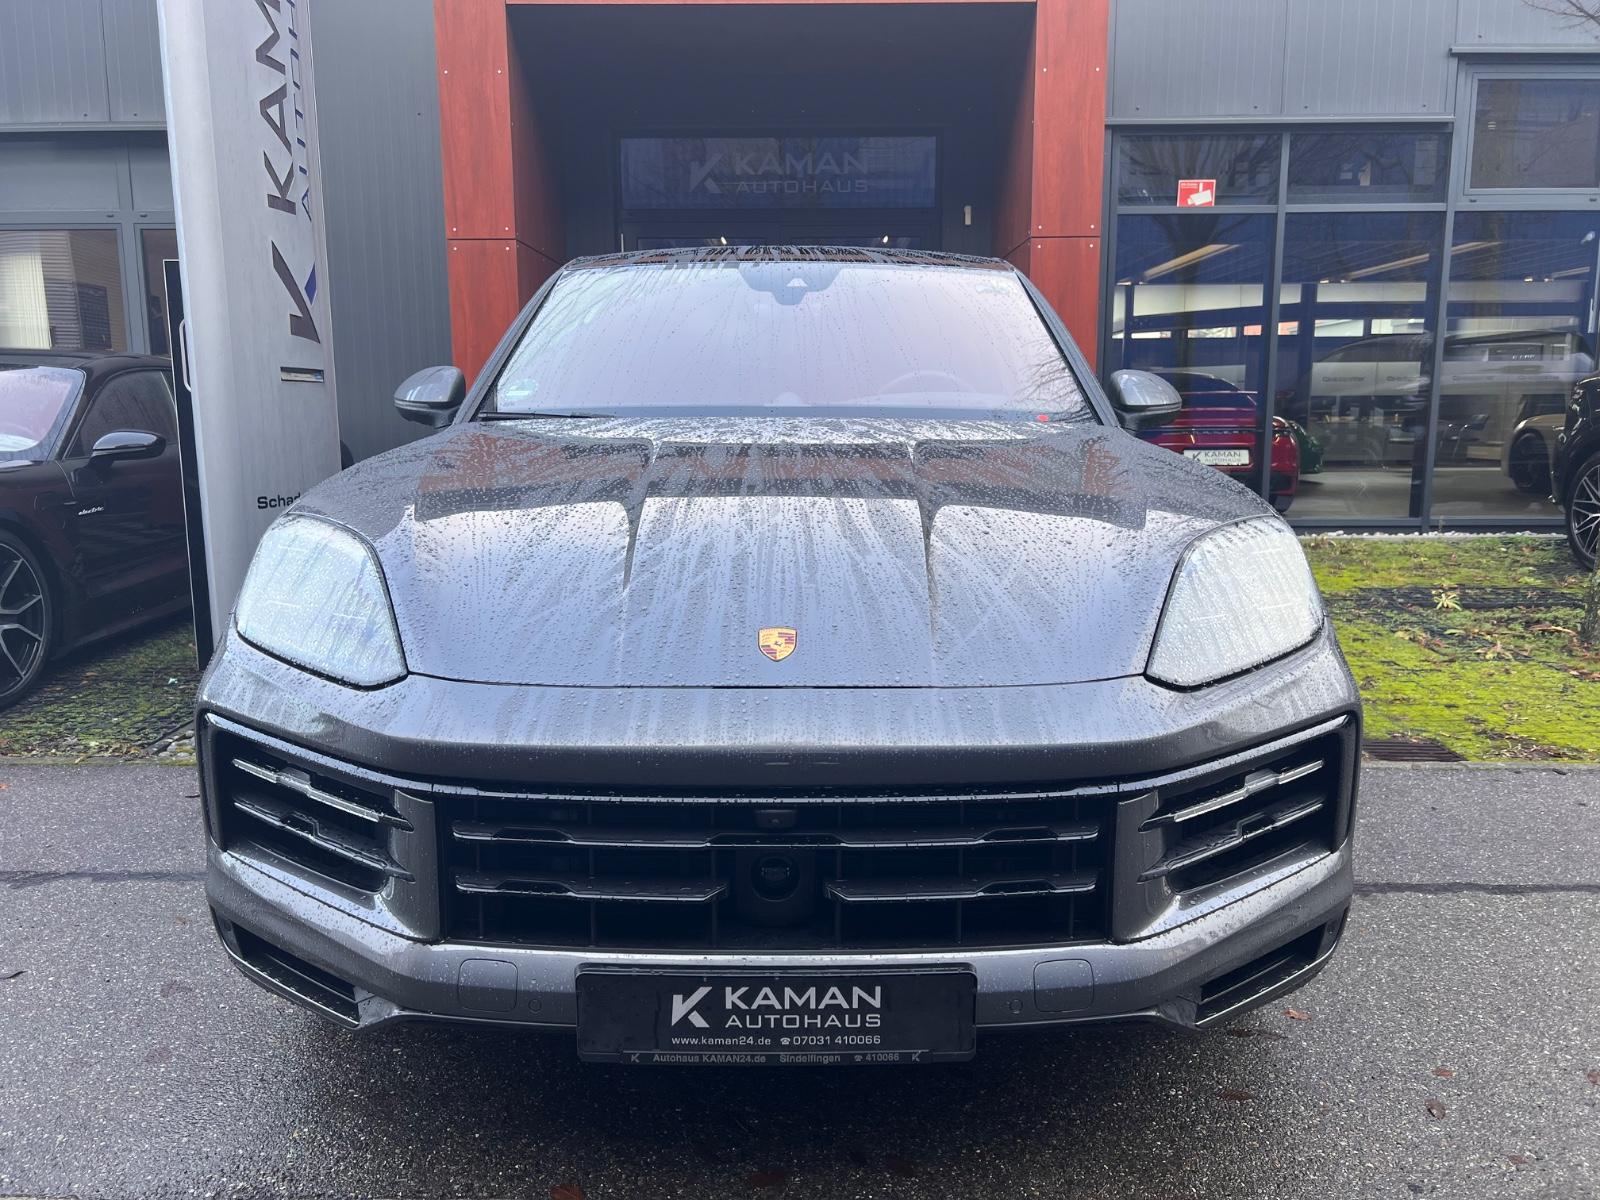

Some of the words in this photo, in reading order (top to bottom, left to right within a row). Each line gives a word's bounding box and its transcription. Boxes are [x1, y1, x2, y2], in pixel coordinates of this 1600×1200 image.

[735, 151, 869, 176] KAMAN
[735, 180, 869, 194] AUTOHAUS
[725, 986, 882, 1010] KAMAN
[725, 1014, 881, 1029] AUTOHAUS
[671, 1036, 772, 1046] www.kaman24.de
[793, 1036, 831, 1046] 07031
[834, 1035, 881, 1045] 410066
[652, 1053, 700, 1063] Autohaus
[702, 1054, 767, 1064] KAMAN24.de
[779, 1053, 841, 1064] Sindelfingen
